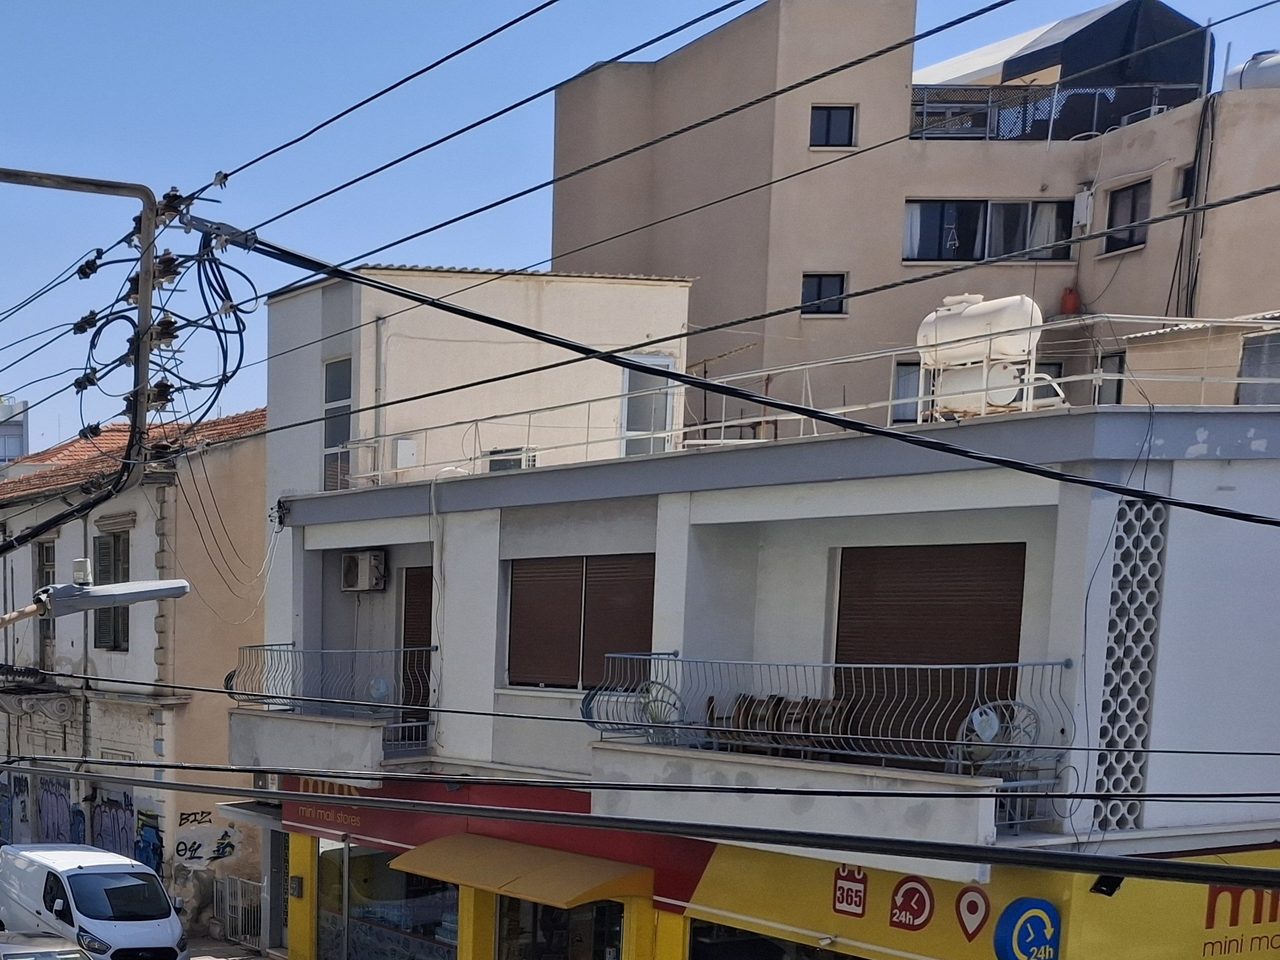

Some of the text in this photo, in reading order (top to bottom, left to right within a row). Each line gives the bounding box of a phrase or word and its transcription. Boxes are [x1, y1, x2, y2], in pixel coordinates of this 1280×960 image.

[299, 806, 360, 826] mini mall stores
[837, 886, 863, 908] 365
[892, 909, 914, 925] 24h
[1203, 934, 1243, 957] mini
